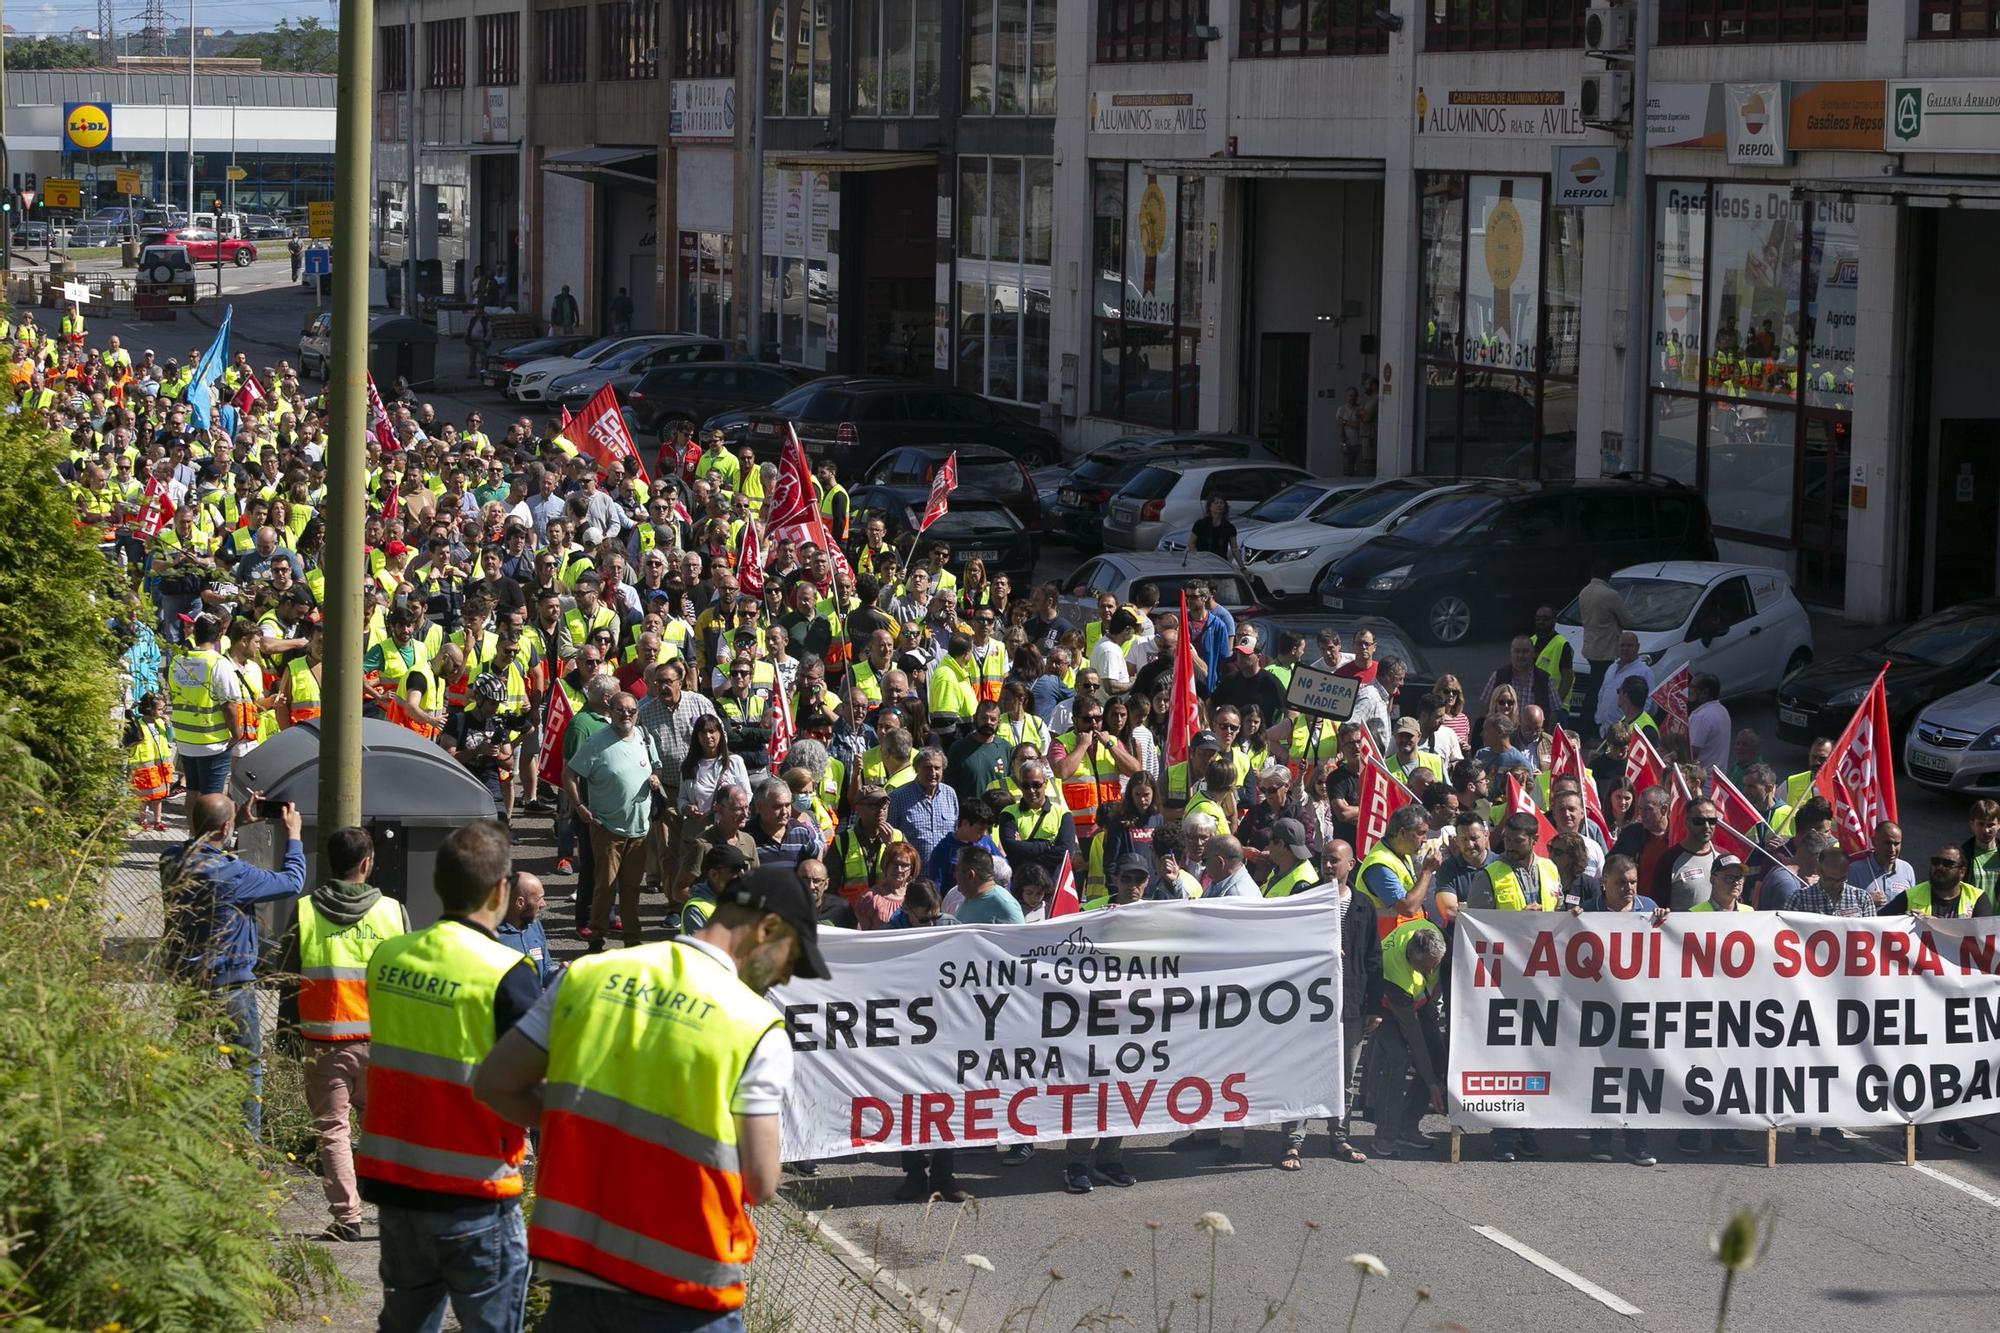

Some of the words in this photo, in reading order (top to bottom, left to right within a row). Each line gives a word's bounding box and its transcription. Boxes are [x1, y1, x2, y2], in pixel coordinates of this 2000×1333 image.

[1926, 92, 1962, 107] GALIANA
[1098, 108, 1152, 130] ALUMINIOS
[1174, 105, 1207, 130] AVILÉS
[1429, 108, 1506, 134] ALUMINIOS
[1807, 114, 1850, 131] Gasóleos
[1738, 144, 1774, 157] REPSOL
[1564, 189, 1609, 199] REPSOL
[1668, 188, 1749, 219] Gasóleos
[1755, 204, 1763, 219] a
[1125, 299, 1140, 318] 984
[1142, 300, 1158, 321] 053
[1490, 341, 1512, 365] 053
[1298, 676, 1313, 689] NO
[1319, 682, 1352, 699] SOBRA
[1304, 694, 1340, 710] NADIE
[1523, 929, 1662, 982] AQUÍ
[1681, 931, 1756, 978] NO
[1773, 930, 1945, 978] SOBRA
[377, 965, 462, 998] SEKURIT
[939, 954, 1180, 989] SAINT-GOBAIN
[605, 973, 717, 1019] SEKURIT
[785, 997, 936, 1051] ERES
[973, 993, 1010, 1041] Y
[1041, 977, 1335, 1038] DESPIDOS
[1487, 998, 1558, 1047] EN
[1580, 998, 1820, 1048] DEFENSA
[1837, 999, 1929, 1046] DEL
[957, 1047, 1065, 1084] PARA
[1088, 1039, 1171, 1077] LOS
[1466, 1076, 1522, 1091] CCOO
[1591, 1067, 1664, 1114] EN
[1682, 1065, 1839, 1115] SAINT
[850, 1072, 1249, 1148] DIRECTIVOS
[1462, 1098, 1526, 1113] industria
